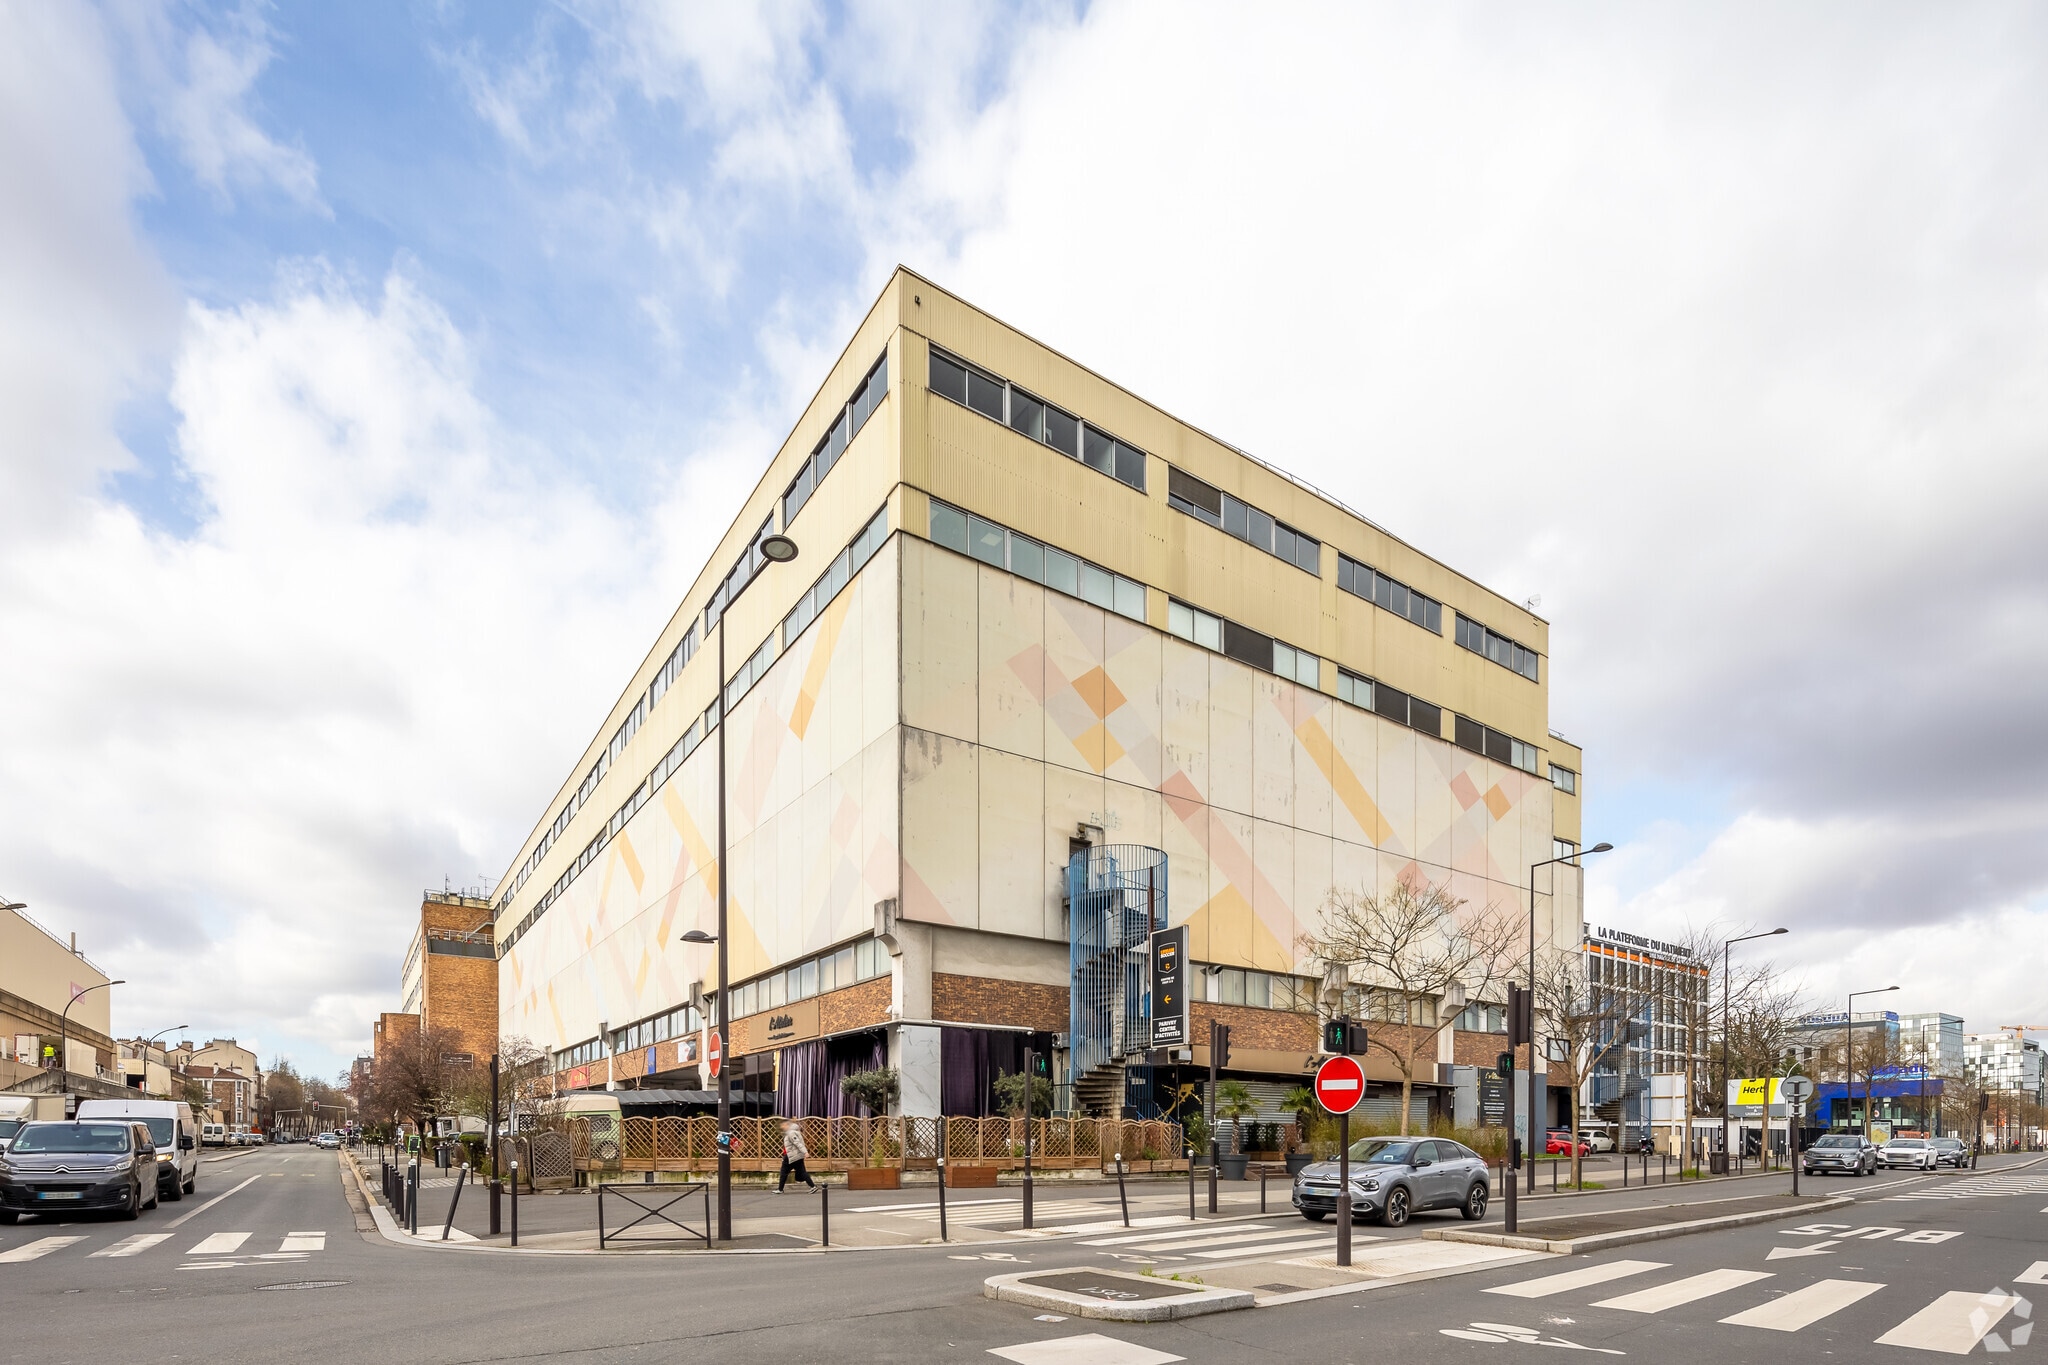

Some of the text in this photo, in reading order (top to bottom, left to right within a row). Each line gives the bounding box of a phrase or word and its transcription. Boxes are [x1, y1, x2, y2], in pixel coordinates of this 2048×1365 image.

[1598, 926, 1607, 938] LA
[1609, 929, 1650, 948] PLATEFORME
[1651, 939, 1660, 950] DU
[1742, 1086, 1765, 1094] Hert
[1778, 1223, 1965, 1244] BUS
